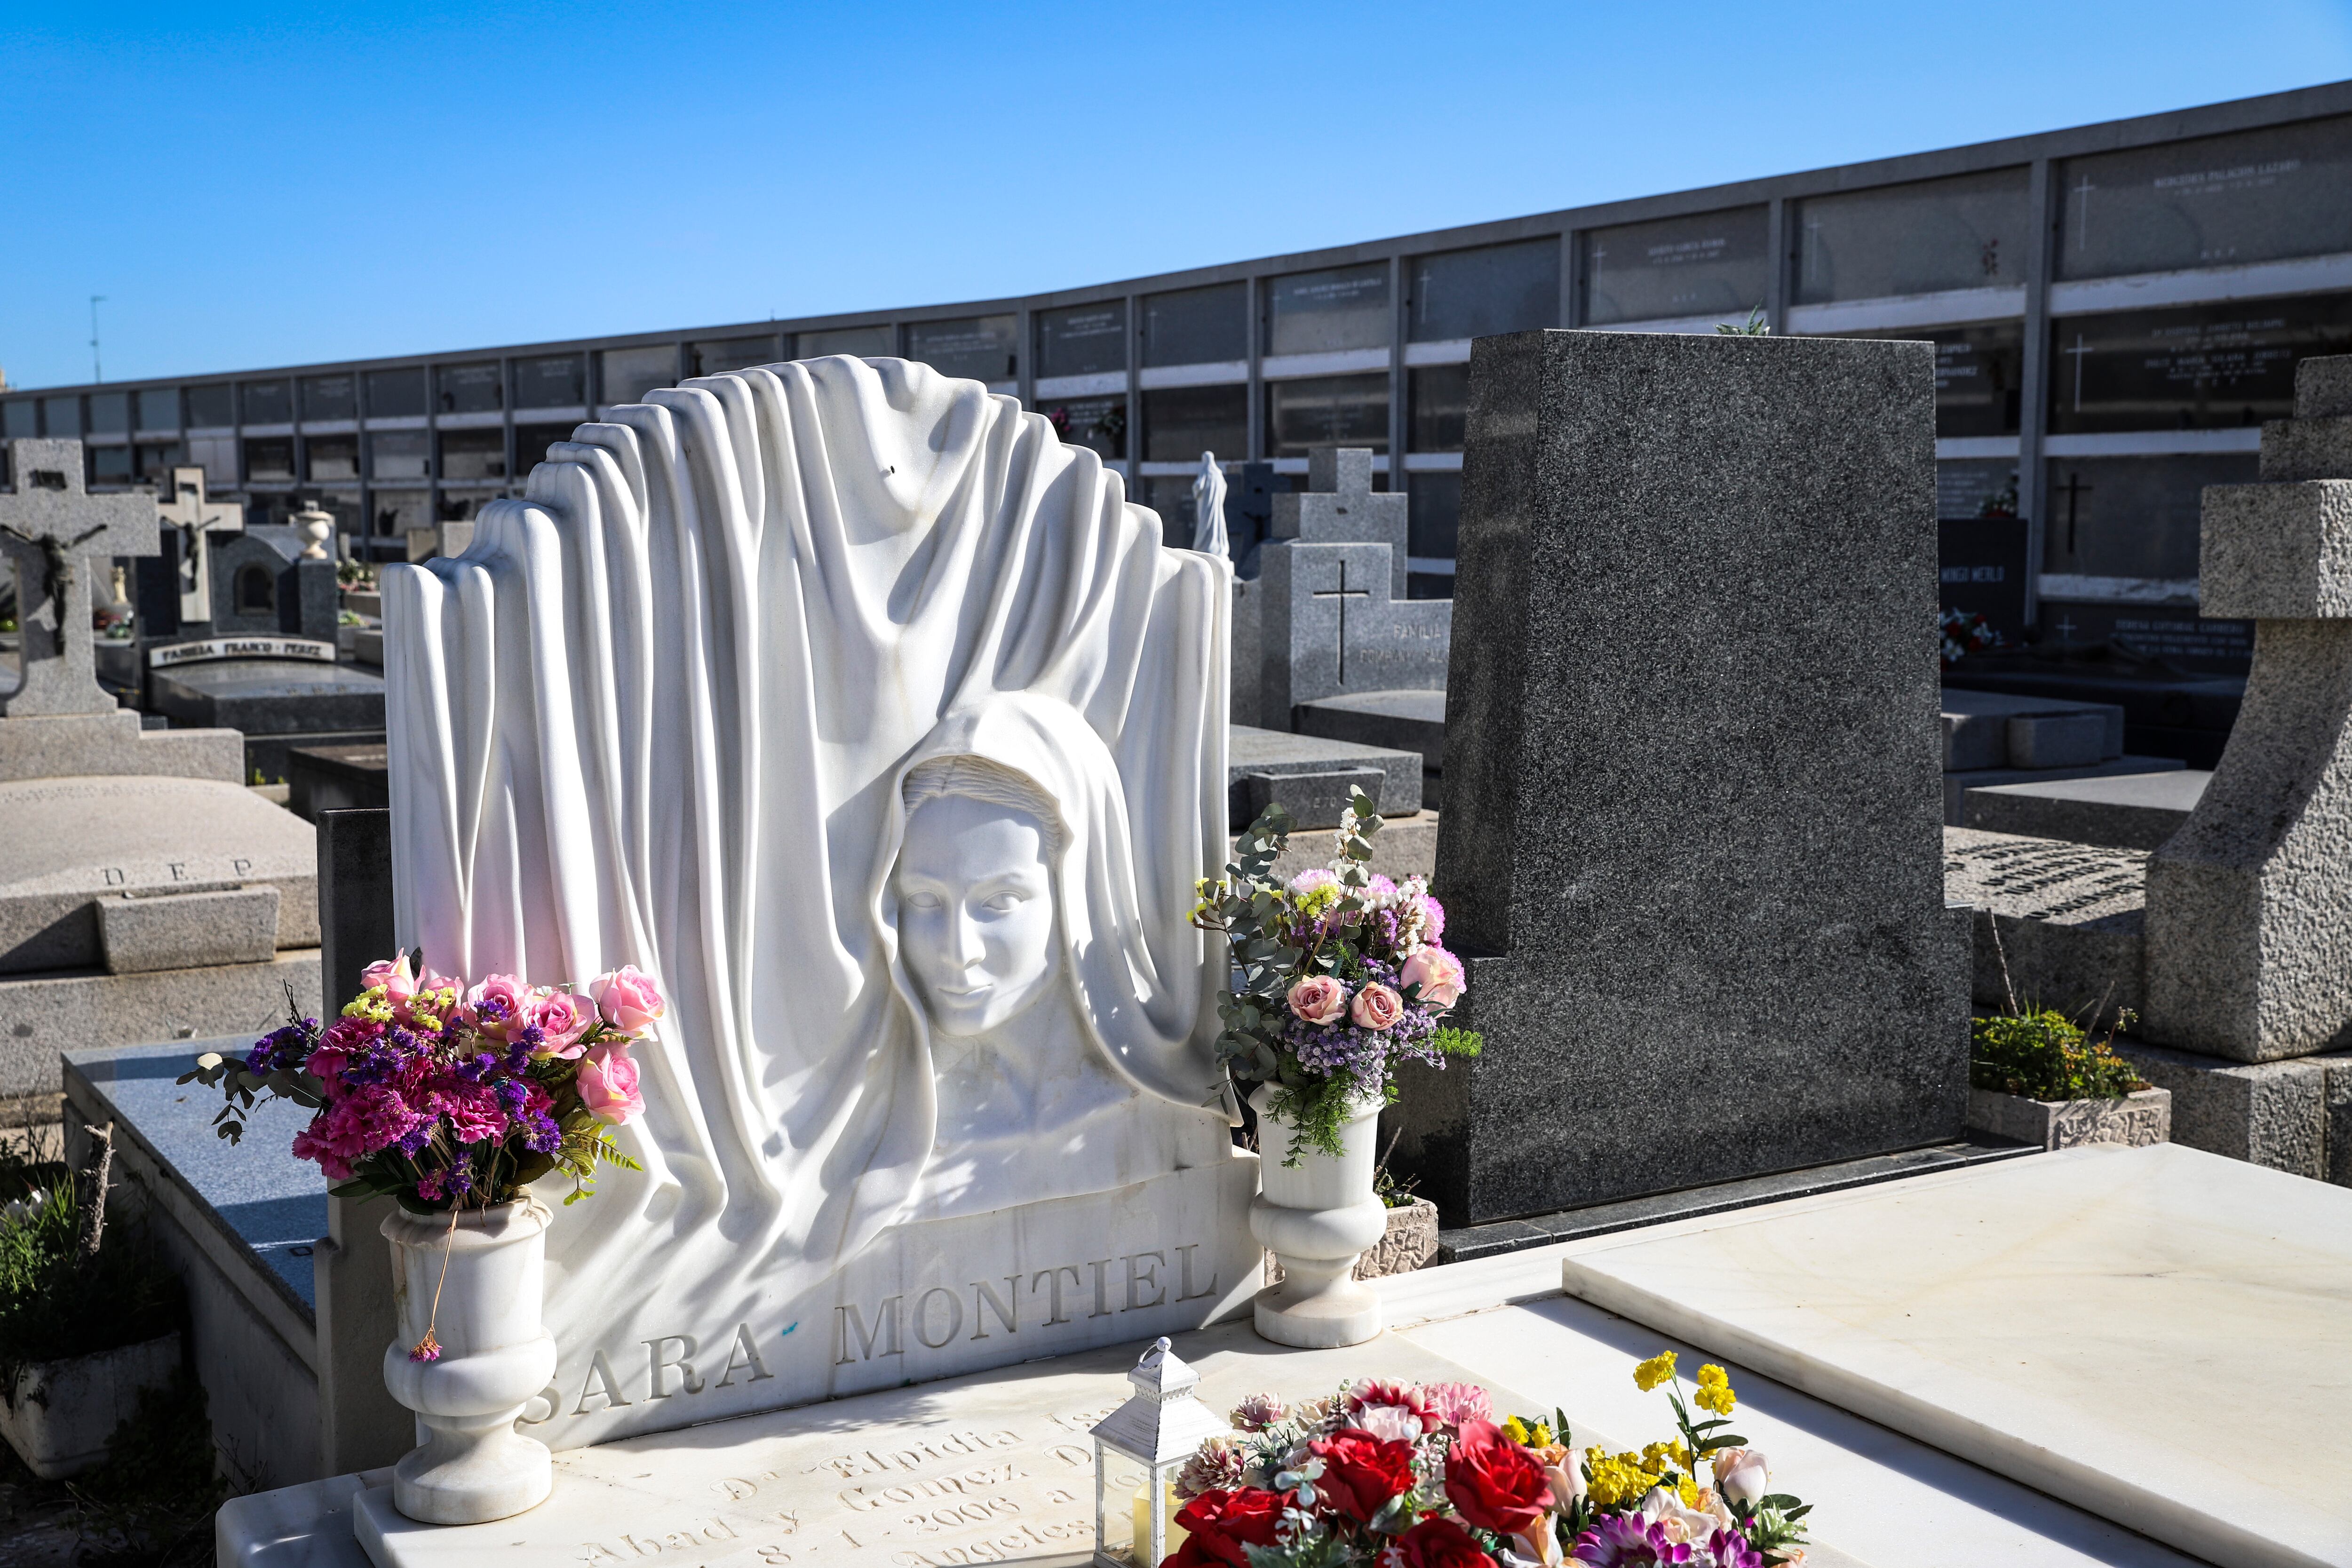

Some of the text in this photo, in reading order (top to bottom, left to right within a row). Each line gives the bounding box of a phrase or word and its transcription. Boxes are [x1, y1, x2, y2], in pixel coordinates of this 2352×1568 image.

[1935, 366, 1979, 378] ERNANDEZ
[163, 642, 322, 661] FAMILIA FRANCO PEREZ
[1394, 624, 1442, 639] FAMILIA
[1312, 796, 1337, 809] 270
[834, 1244, 1219, 1366] MONTIEL
[819, 1430, 1025, 1479] Elpidia
[903, 1496, 1020, 1536] 2006
[575, 1516, 740, 1568] Abad
[891, 1520, 1095, 1568] Angeles
